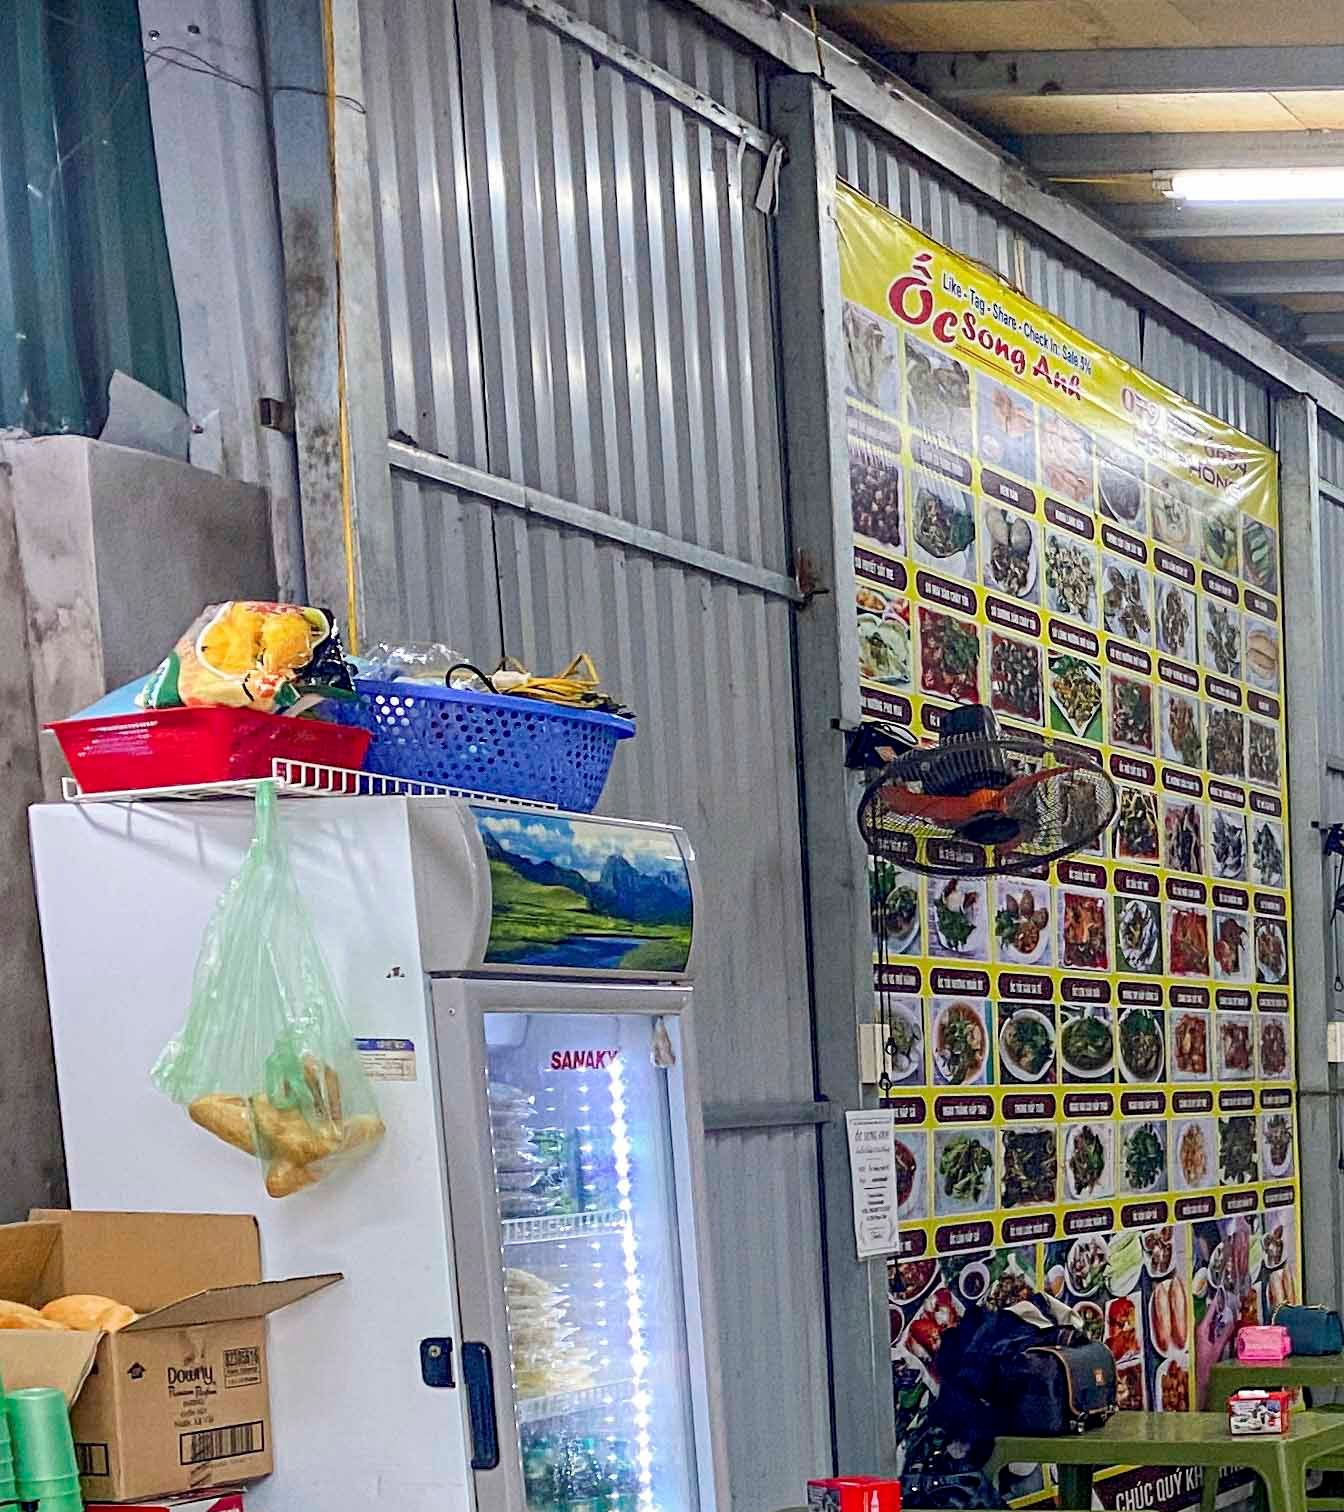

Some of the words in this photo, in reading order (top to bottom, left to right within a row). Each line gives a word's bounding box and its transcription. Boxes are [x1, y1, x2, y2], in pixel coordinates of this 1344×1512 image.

[167, 1364, 214, 1386] Downy
[1115, 1480, 1154, 1512] CHÚC
[1156, 1467, 1183, 1502] QUÝ
